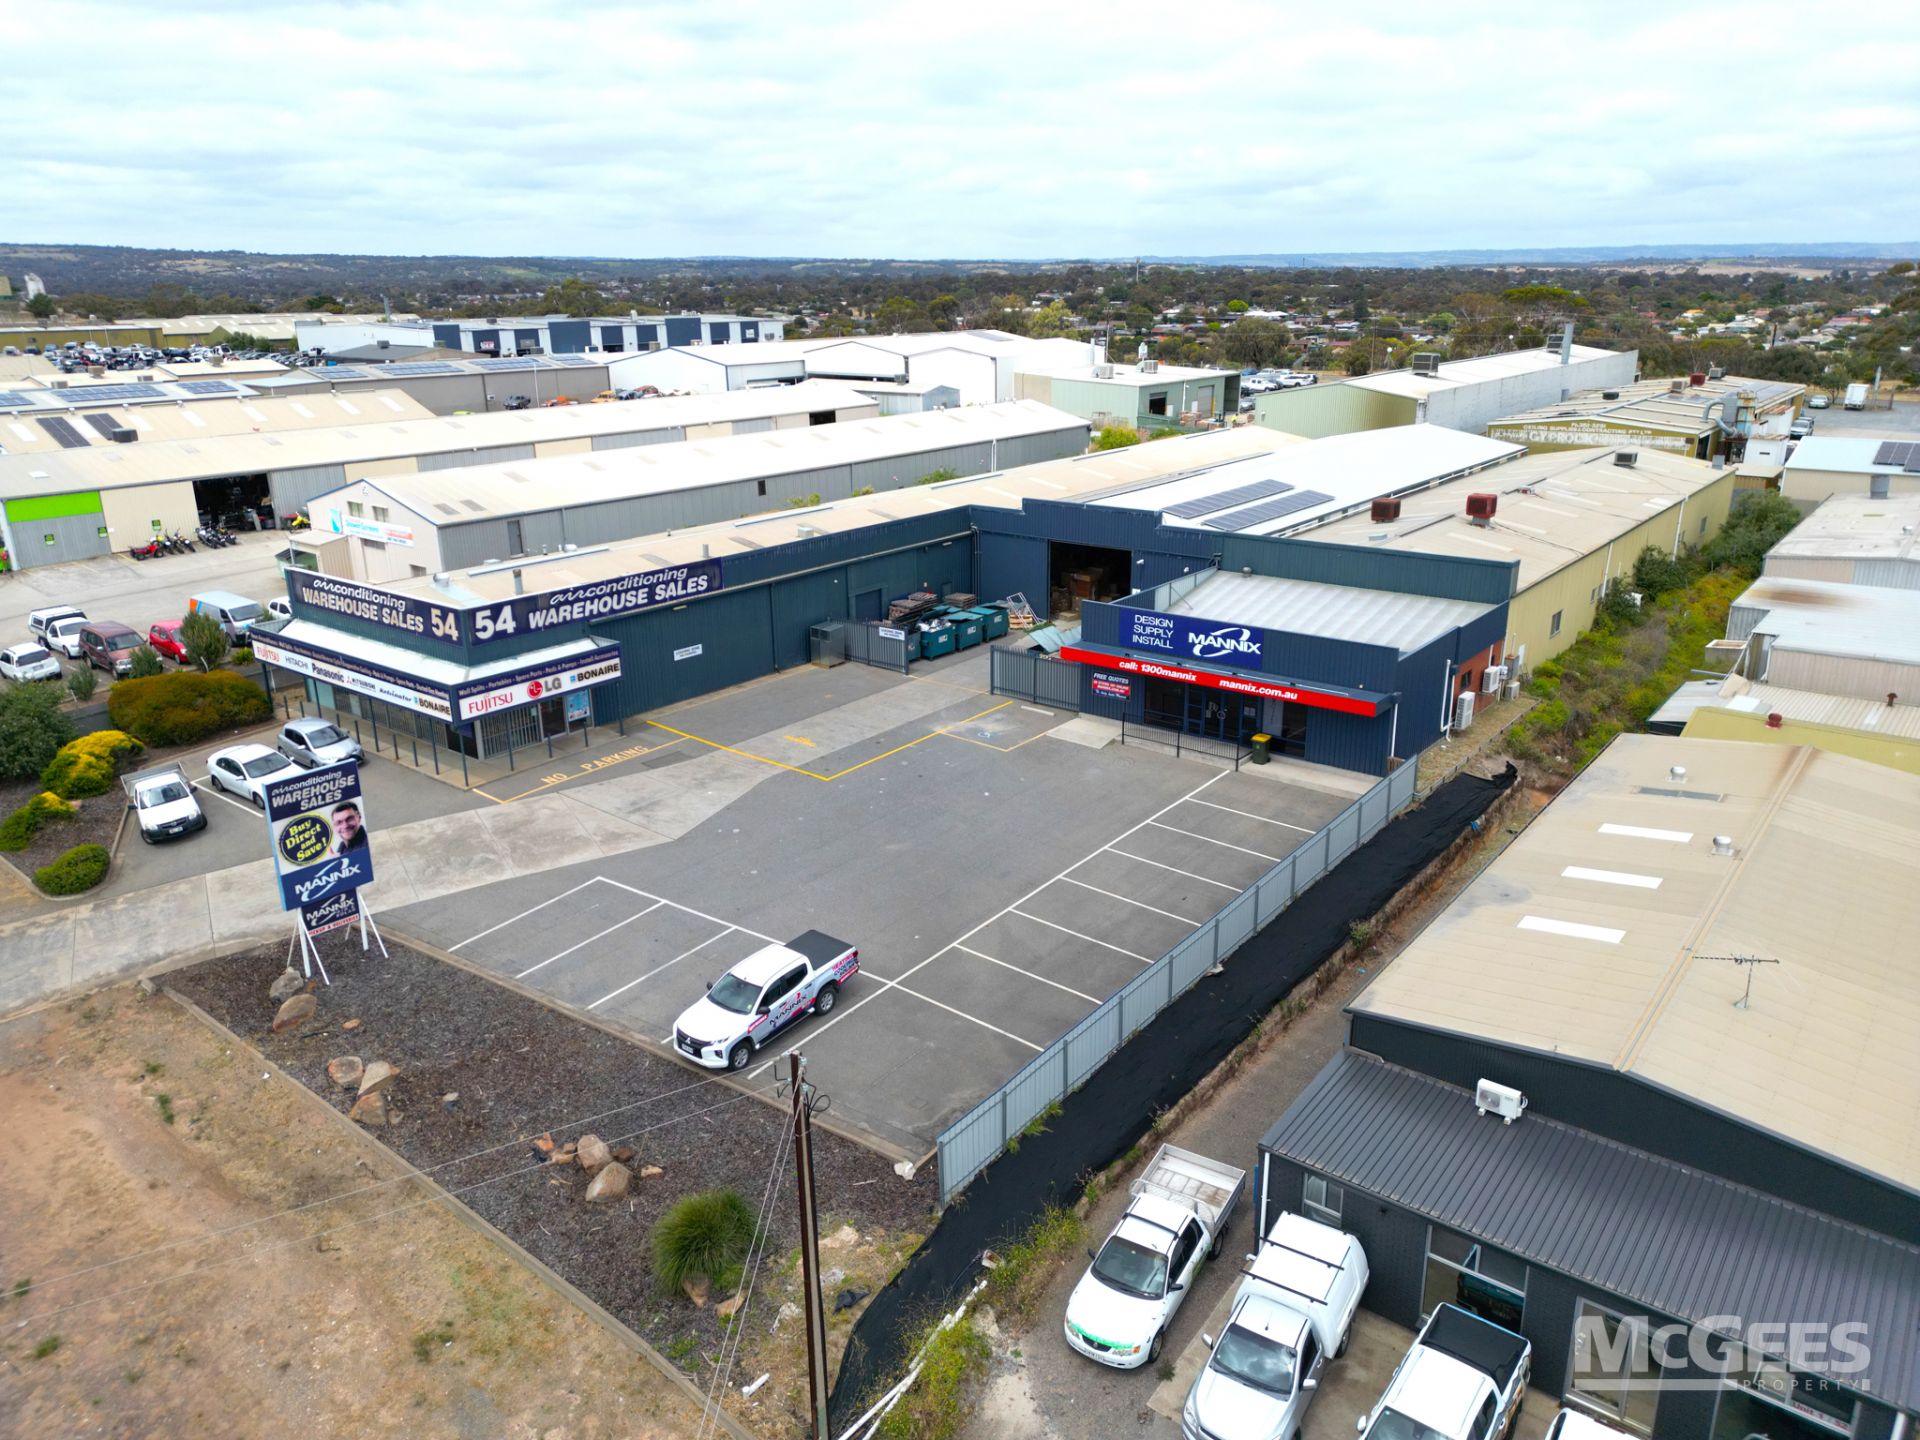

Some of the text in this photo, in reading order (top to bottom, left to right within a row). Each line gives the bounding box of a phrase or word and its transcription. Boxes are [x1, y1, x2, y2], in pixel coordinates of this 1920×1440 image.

[313, 577, 406, 612] airconditioning
[550, 567, 688, 606] airconditioning
[303, 587, 424, 633] WAREHOUSE SALES
[528, 575, 708, 630] WAREHOUSE SALES
[430, 607, 459, 641] 54
[475, 605, 516, 640] 54
[1133, 624, 1174, 639] SUPPLY
[1134, 614, 1174, 629] DESIGN
[1132, 635, 1174, 649] INSTALL
[1188, 631, 1262, 655] MANNIX
[256, 646, 281, 662] FUJITSU
[285, 655, 309, 669] HITACHI
[311, 662, 345, 683] Panasonic
[577, 663, 620, 682] BONAIRE
[1093, 672, 1108, 681] FREE
[1108, 675, 1129, 685] QUOTES
[1119, 660, 1197, 682] call: 1300mannix
[544, 677, 562, 692] LG
[1219, 679, 1298, 700] mannix.com.au
[418, 697, 451, 716] BONAIRE
[468, 692, 513, 714] FUJITSU
[541, 745, 649, 784] NO PARKING
[271, 771, 342, 796] airconditioning
[271, 774, 356, 808] WAREHOUSE
[300, 790, 342, 811] SALES
[285, 823, 321, 850] Direct
[289, 819, 311, 837] Buy
[300, 836, 316, 850] and
[295, 863, 361, 895] MANNIX
[306, 897, 354, 921] MANNIX
